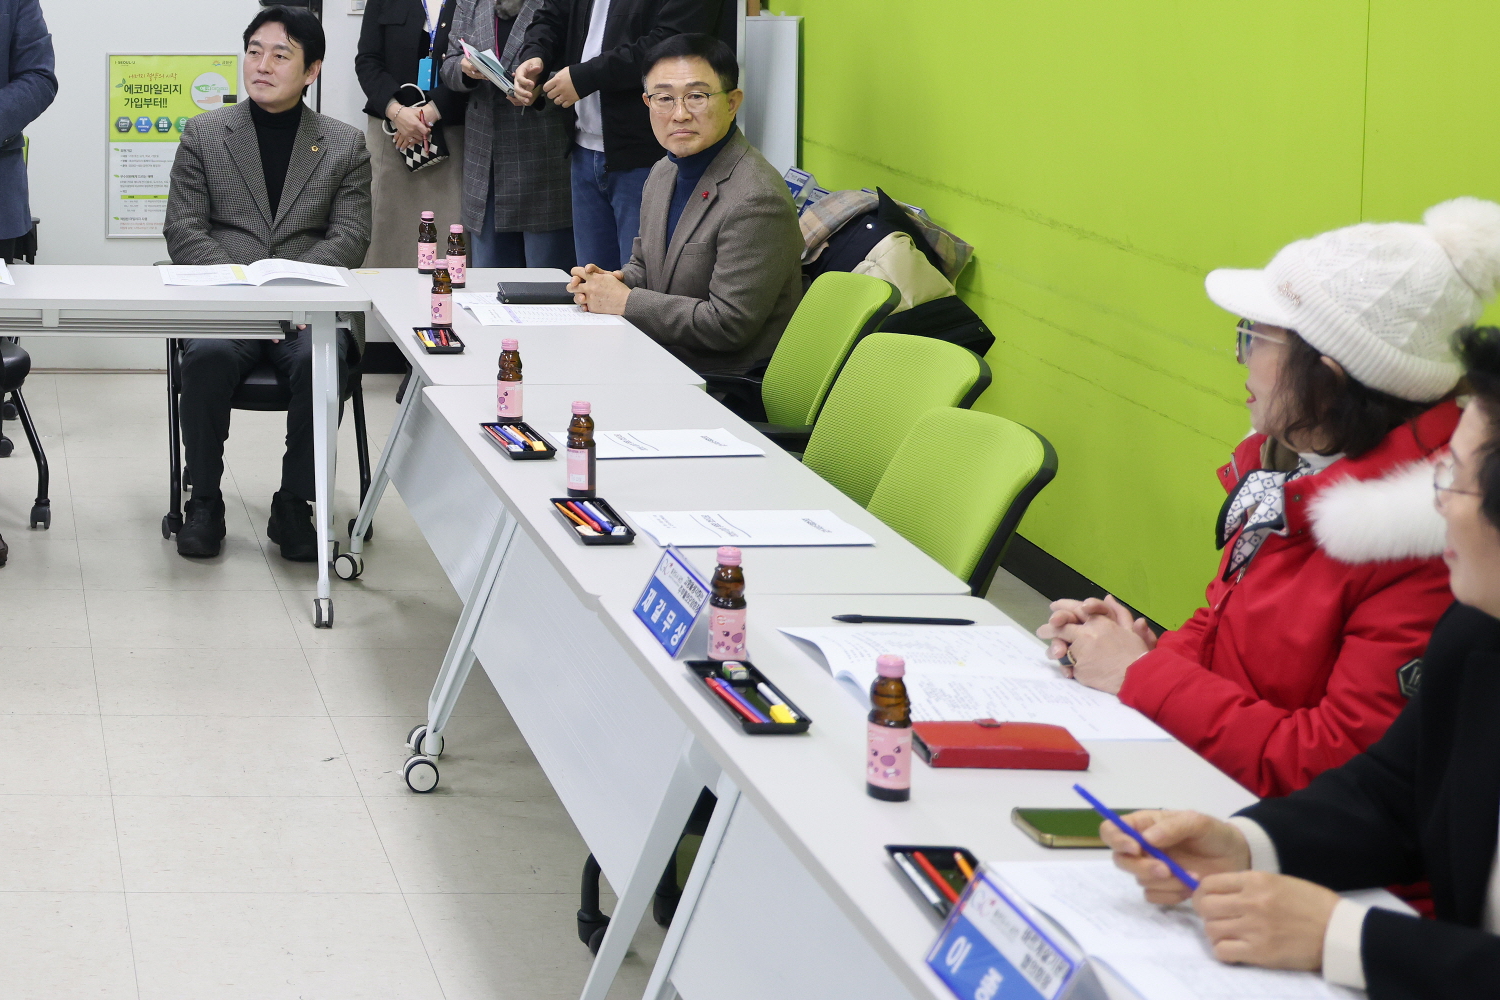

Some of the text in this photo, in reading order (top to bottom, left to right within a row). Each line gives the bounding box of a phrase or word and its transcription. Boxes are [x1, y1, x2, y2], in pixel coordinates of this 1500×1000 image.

[124, 84, 182, 94] 에코마일리지
[124, 98, 168, 108] 가입부터!!
[641, 588, 687, 646] 제갈무상
